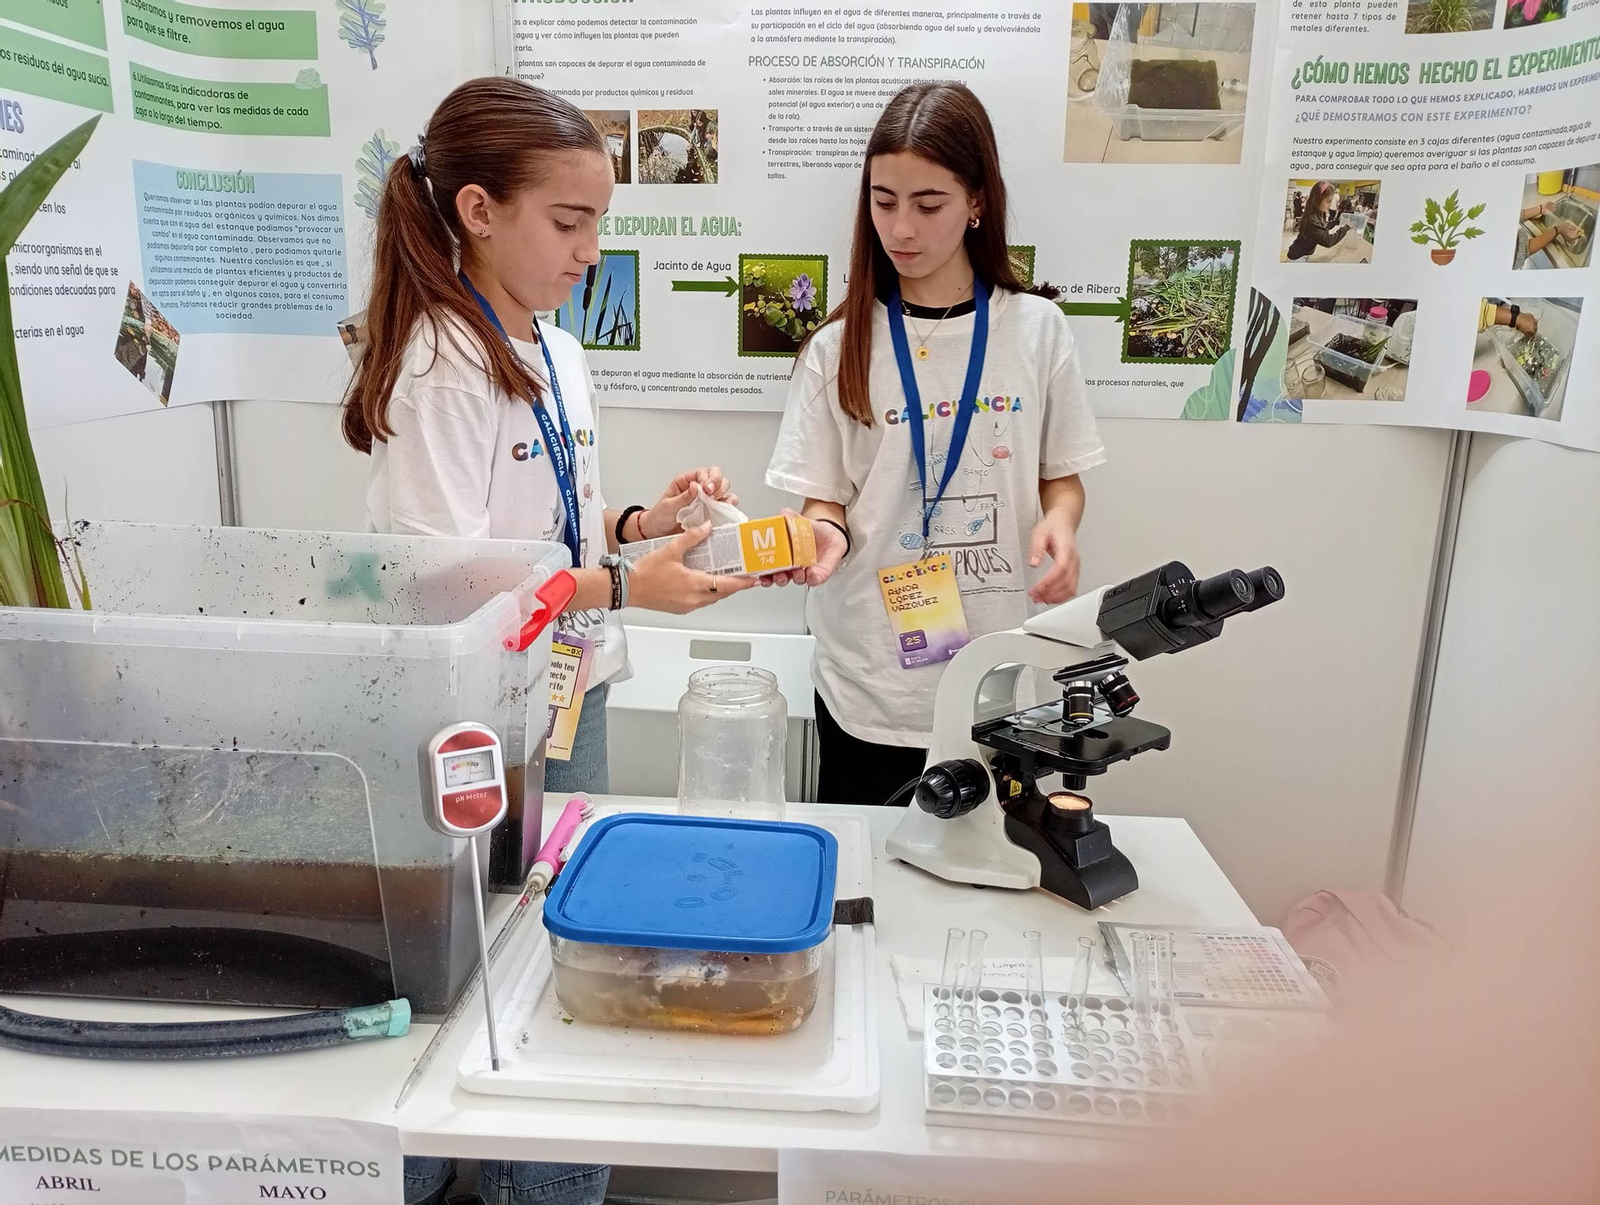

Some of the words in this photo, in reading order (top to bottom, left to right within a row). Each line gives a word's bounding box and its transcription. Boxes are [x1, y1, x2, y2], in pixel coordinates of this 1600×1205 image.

[765, 8, 792, 17] plantas
[793, 8, 822, 17] influyen
[874, 9, 910, 17] diferentes
[946, 11, 999, 20] principalmente
[1007, 12, 1030, 20] través
[1326, 12, 1349, 20] hasta
[1353, 12, 1358, 20] 7
[1362, 13, 1382, 22] tipos
[1385, 13, 1397, 21] de
[126, 15, 143, 29] para
[144, 22, 156, 34] que
[157, 26, 165, 37] se
[166, 27, 191, 44] filtre.
[168, 12, 174, 23] y
[175, 13, 242, 30] removemos
[245, 19, 255, 30] el
[257, 21, 285, 33] agua
[528, 18, 555, 27] explicar
[576, 18, 608, 28] podemos
[609, 18, 639, 26] detectar
[647, 17, 698, 26] contaminación
[1290, 24, 1322, 32] metales
[1325, 24, 1369, 33] diferentes.
[765, 34, 802, 43] atmósfera
[803, 35, 837, 43] mediante
[846, 35, 897, 45] transpiración).
[518, 59, 544, 68] plantas
[558, 61, 586, 69] capaces
[597, 60, 625, 69] depurar
[633, 61, 651, 69] agua
[652, 59, 696, 67] contaminada
[748, 55, 800, 67] PROCESO
[803, 55, 817, 67] DE
[820, 54, 885, 68] ABSORCIÓN
[887, 56, 895, 67] Y
[897, 56, 985, 70] TRANSPIRACIÓN
[13, 52, 50, 71] residuos
[51, 60, 65, 75] del
[66, 67, 87, 81] agua
[87, 73, 109, 87] sucia.
[1291, 55, 1350, 90] ¿CÓMO
[1353, 62, 1410, 85] HEMOS
[1419, 59, 1478, 84] HECHO
[1482, 57, 1503, 81] EL
[133, 71, 165, 89] 6.Utilizamos
[165, 81, 180, 93] tiras
[180, 84, 235, 100] indicadoras
[237, 90, 249, 100] de
[1295, 94, 1317, 103] PARA
[1318, 95, 1370, 104] COMPROBAR
[1372, 95, 1395, 104] TODO
[1397, 96, 1409, 104] LO
[1410, 95, 1428, 105] QUE
[1429, 94, 1461, 103] HEMOS
[1463, 89, 1516, 102] EXPLICADO.
[1518, 82, 1557, 96] HAREMOS
[1558, 80, 1569, 90] UN
[134, 90, 176, 109] contaminantes,
[176, 101, 196, 111] para
[197, 104, 214, 113] ver
[216, 104, 231, 115] las
[233, 105, 271, 115] medidas
[272, 106, 284, 116] de
[286, 106, 309, 116] cada
[135, 106, 147, 118] caja
[159, 110, 174, 124] largo
[175, 114, 186, 125] del
[187, 116, 222, 130] tiempo.
[1295, 109, 1321, 123] ¿QUÉ
[1323, 112, 1398, 122] DEMOSTRAMOS
[1400, 112, 1424, 122] CON
[1426, 111, 1451, 122] ESTE
[1454, 104, 1532, 121] EXPERIMENTO?
[768, 124, 806, 133] Transporte:
[1293, 136, 1324, 145] Nuestro
[1324, 137, 1373, 146] experimento
[1374, 138, 1406, 146] consiste
[1427, 137, 1449, 147] cajas
[1451, 136, 1495, 145] diferentes
[768, 148, 813, 157] Transpiración:
[177, 169, 255, 193] CONCLUSIÓN
[54, 201, 66, 214] los
[215, 200, 247, 209] plantas
[277, 202, 307, 211] depurar
[214, 211, 256, 221] orgánicos
[264, 213, 299, 222] químicos.
[614, 216, 677, 236] DEPURAN
[681, 216, 697, 236] EL
[700, 216, 742, 237] AGUA:
[13, 244, 83, 258] microorganismos
[84, 247, 94, 256] en
[95, 245, 102, 257] el
[14, 263, 42, 275] siendo
[44, 266, 60, 275] una
[61, 263, 82, 276] señal
[95, 267, 109, 278] que
[653, 260, 689, 271] Jacinto
[691, 261, 703, 271] de
[706, 261, 731, 273] Agua
[10, 281, 53, 297] ondiciones
[54, 283, 97, 296] adecuadas
[98, 286, 116, 297] para
[197, 278, 235, 288] conseguir
[306, 281, 347, 290] convertirla
[1070, 283, 1083, 294] de
[1086, 283, 1120, 294] Ribera
[240, 301, 272, 310] grandes
[274, 302, 313, 311] problemas
[15, 326, 43, 338] cterias
[65, 326, 84, 338] agua
[1131, 379, 1168, 388] naturales,
[885, 396, 1022, 425] CAICINCIA
[541, 413, 565, 477] CALICIENCIA
[752, 526, 776, 550] M
[955, 547, 1012, 583] PIQUES
[905, 635, 921, 646] 25
[455, 796, 465, 804] pH
[466, 791, 488, 799] Meter
[0, 1145, 102, 1165] MEDIDAS
[111, 1149, 144, 1168] DE
[152, 1151, 199, 1172] LOS
[208, 1153, 380, 1178] PARÁMETROS
[36, 1176, 100, 1191] ABRIL
[259, 1185, 326, 1200] MAYO
